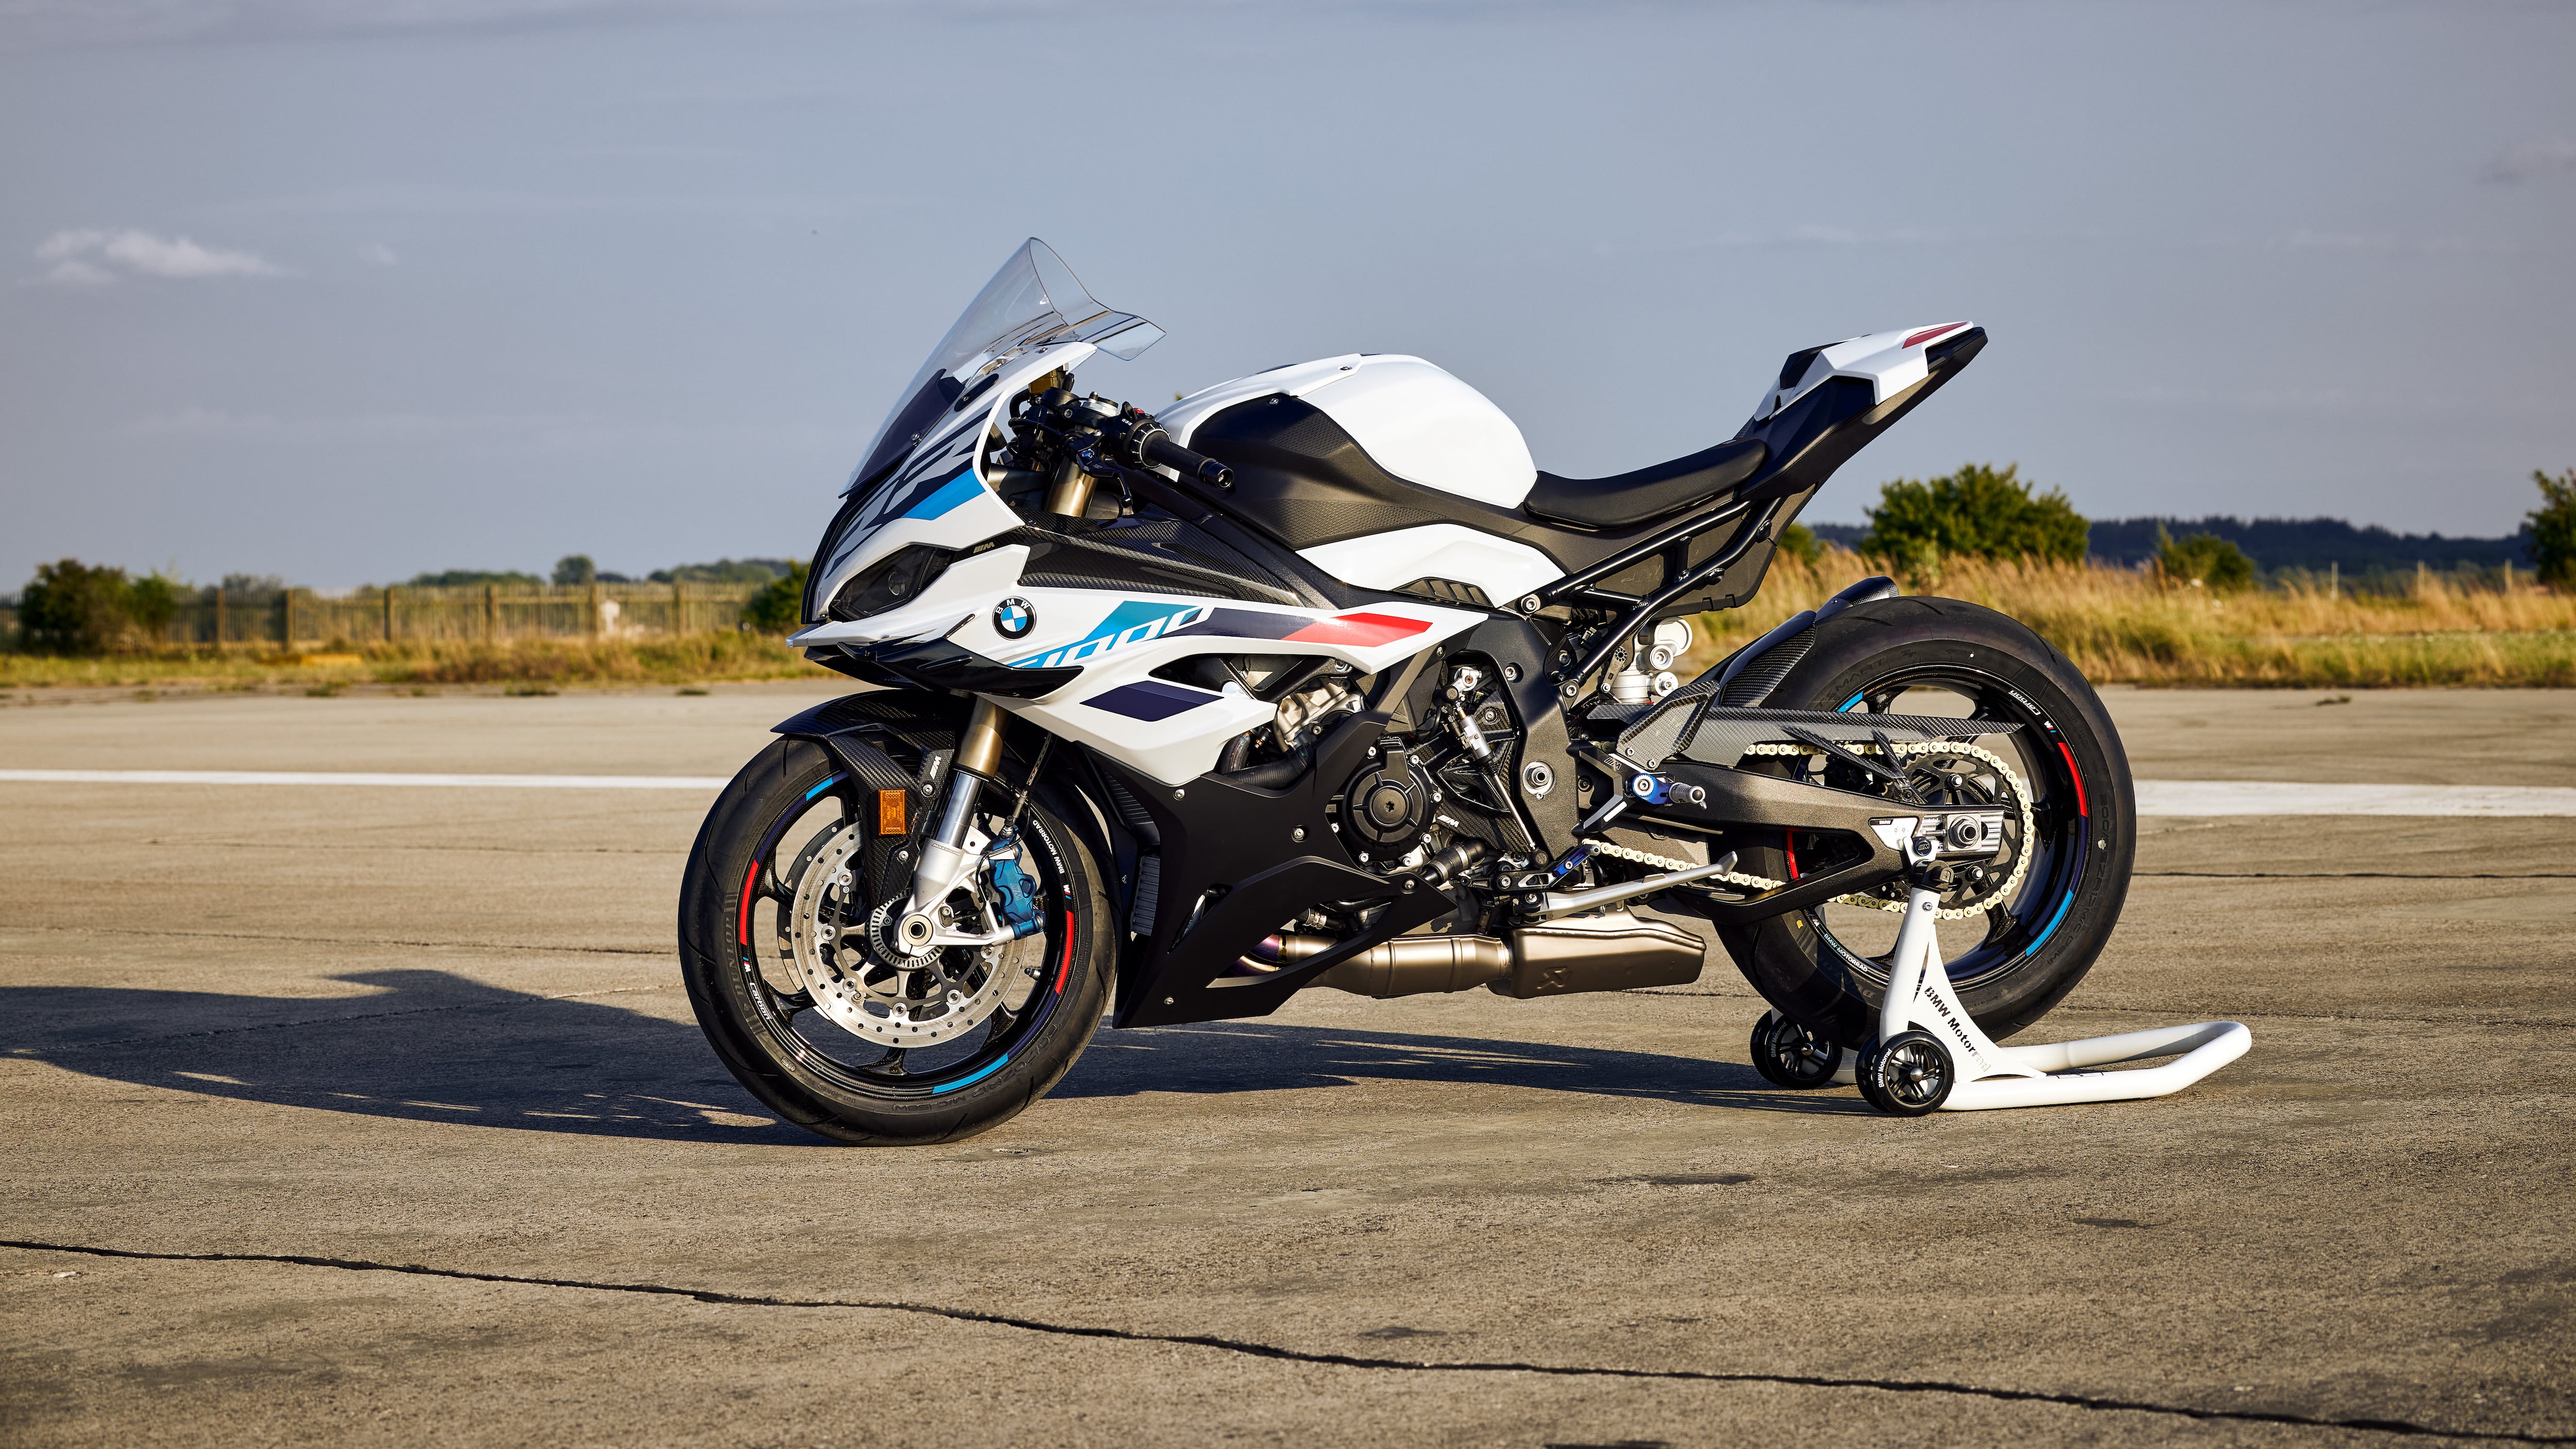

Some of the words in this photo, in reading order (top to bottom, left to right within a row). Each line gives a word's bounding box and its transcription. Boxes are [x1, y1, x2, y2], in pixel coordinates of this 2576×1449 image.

[995, 598, 1030, 615] BMW
[2008, 689, 2041, 716] Carbon
[1032, 820, 1058, 857] MOTORRAD
[1054, 855, 1065, 874] BMW
[725, 916, 746, 999] DUNLOP
[1823, 933, 1838, 948] BMW
[1836, 947, 1869, 973] MOTORRAD
[749, 981, 772, 1022] Carbon
[1772, 1021, 1787, 1043] Motorrad
[1924, 986, 1951, 1017] BMW
[1947, 1017, 1991, 1072] Motorrad
[1878, 1048, 1893, 1072] Motorrad
[842, 1095, 856, 1104] DOT
